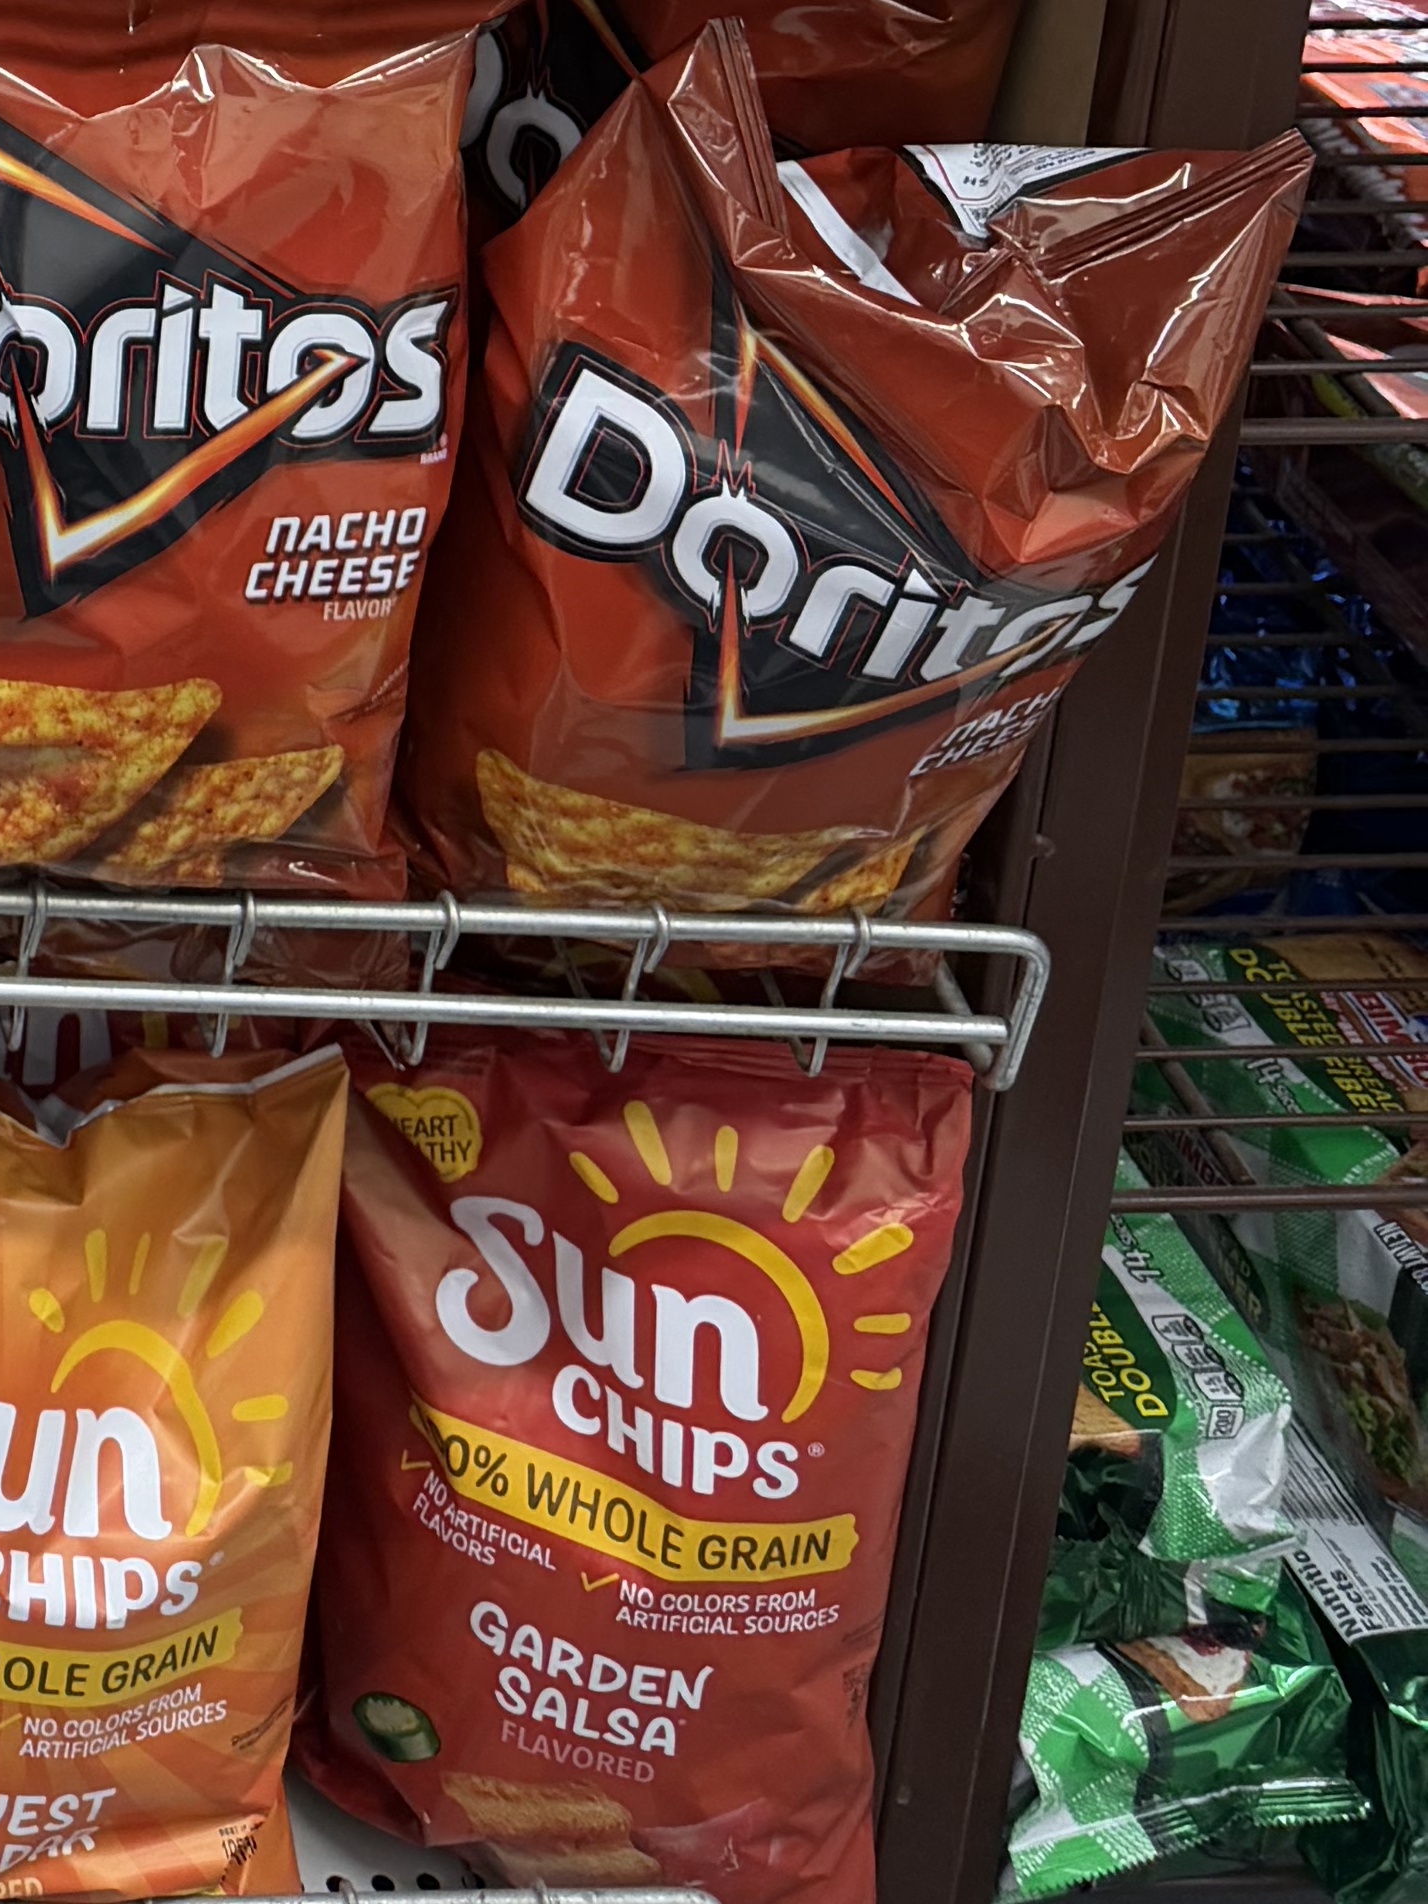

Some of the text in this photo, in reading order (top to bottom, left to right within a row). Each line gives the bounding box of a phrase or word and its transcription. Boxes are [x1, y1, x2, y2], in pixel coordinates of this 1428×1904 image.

[265, 507, 427, 553] NACHO
[524, 368, 1160, 681] Doritos
[244, 550, 419, 601] CHEESE
[435, 1196, 767, 1420] Sun
[552, 1364, 798, 1499] CHIPS
[413, 1497, 496, 1567] FLAVORS
[423, 1469, 556, 1572] NO ARTIFICIAL
[526, 1461, 831, 1573] WHOLE GRAIN
[102, 1622, 219, 1695] GRAIN
[469, 1601, 713, 1710] GARDEN
[19, 1699, 227, 1758] ARTIFICIAL SOURCES
[24, 1683, 202, 1739] NO COLORS FROM
[495, 1666, 676, 1755] SALSA
[501, 1721, 655, 1784] FLAVORED
